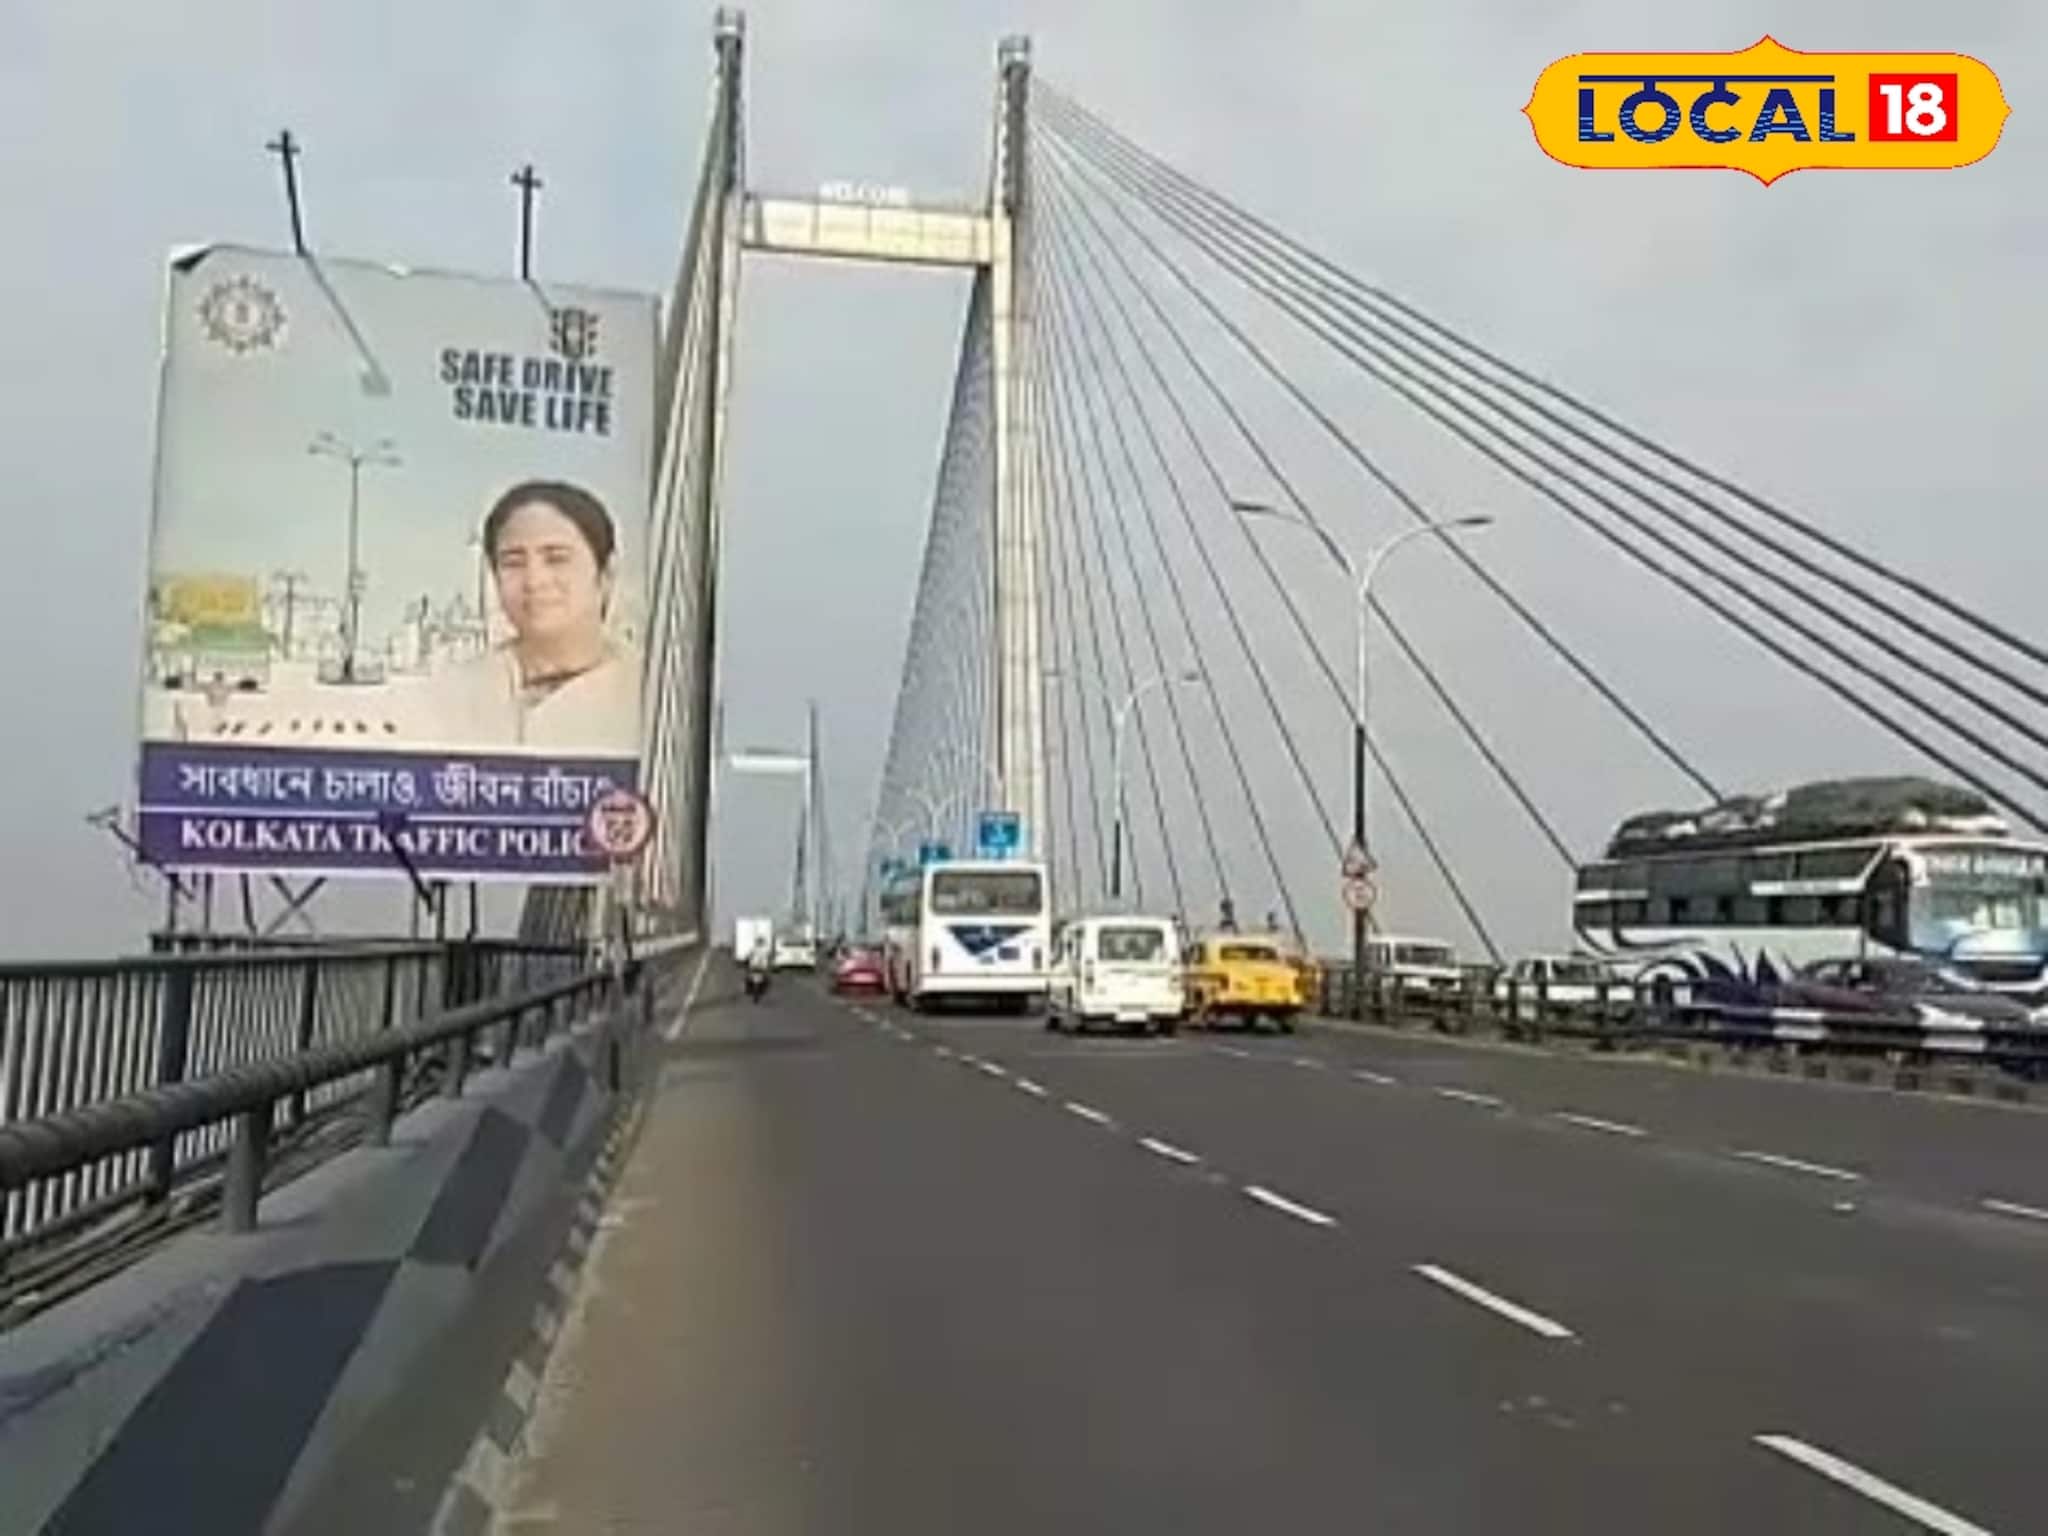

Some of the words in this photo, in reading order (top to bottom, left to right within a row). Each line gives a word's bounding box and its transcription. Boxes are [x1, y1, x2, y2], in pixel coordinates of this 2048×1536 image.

[440, 349, 514, 387] SAFE
[522, 357, 614, 398] DRIVE
[454, 387, 537, 426] SAVE
[546, 396, 611, 436] LIFE
[178, 764, 313, 799] সাবধানে
[432, 763, 524, 807] জীবন
[181, 818, 341, 851] KOLKATA
[500, 827, 597, 858] POLIC
